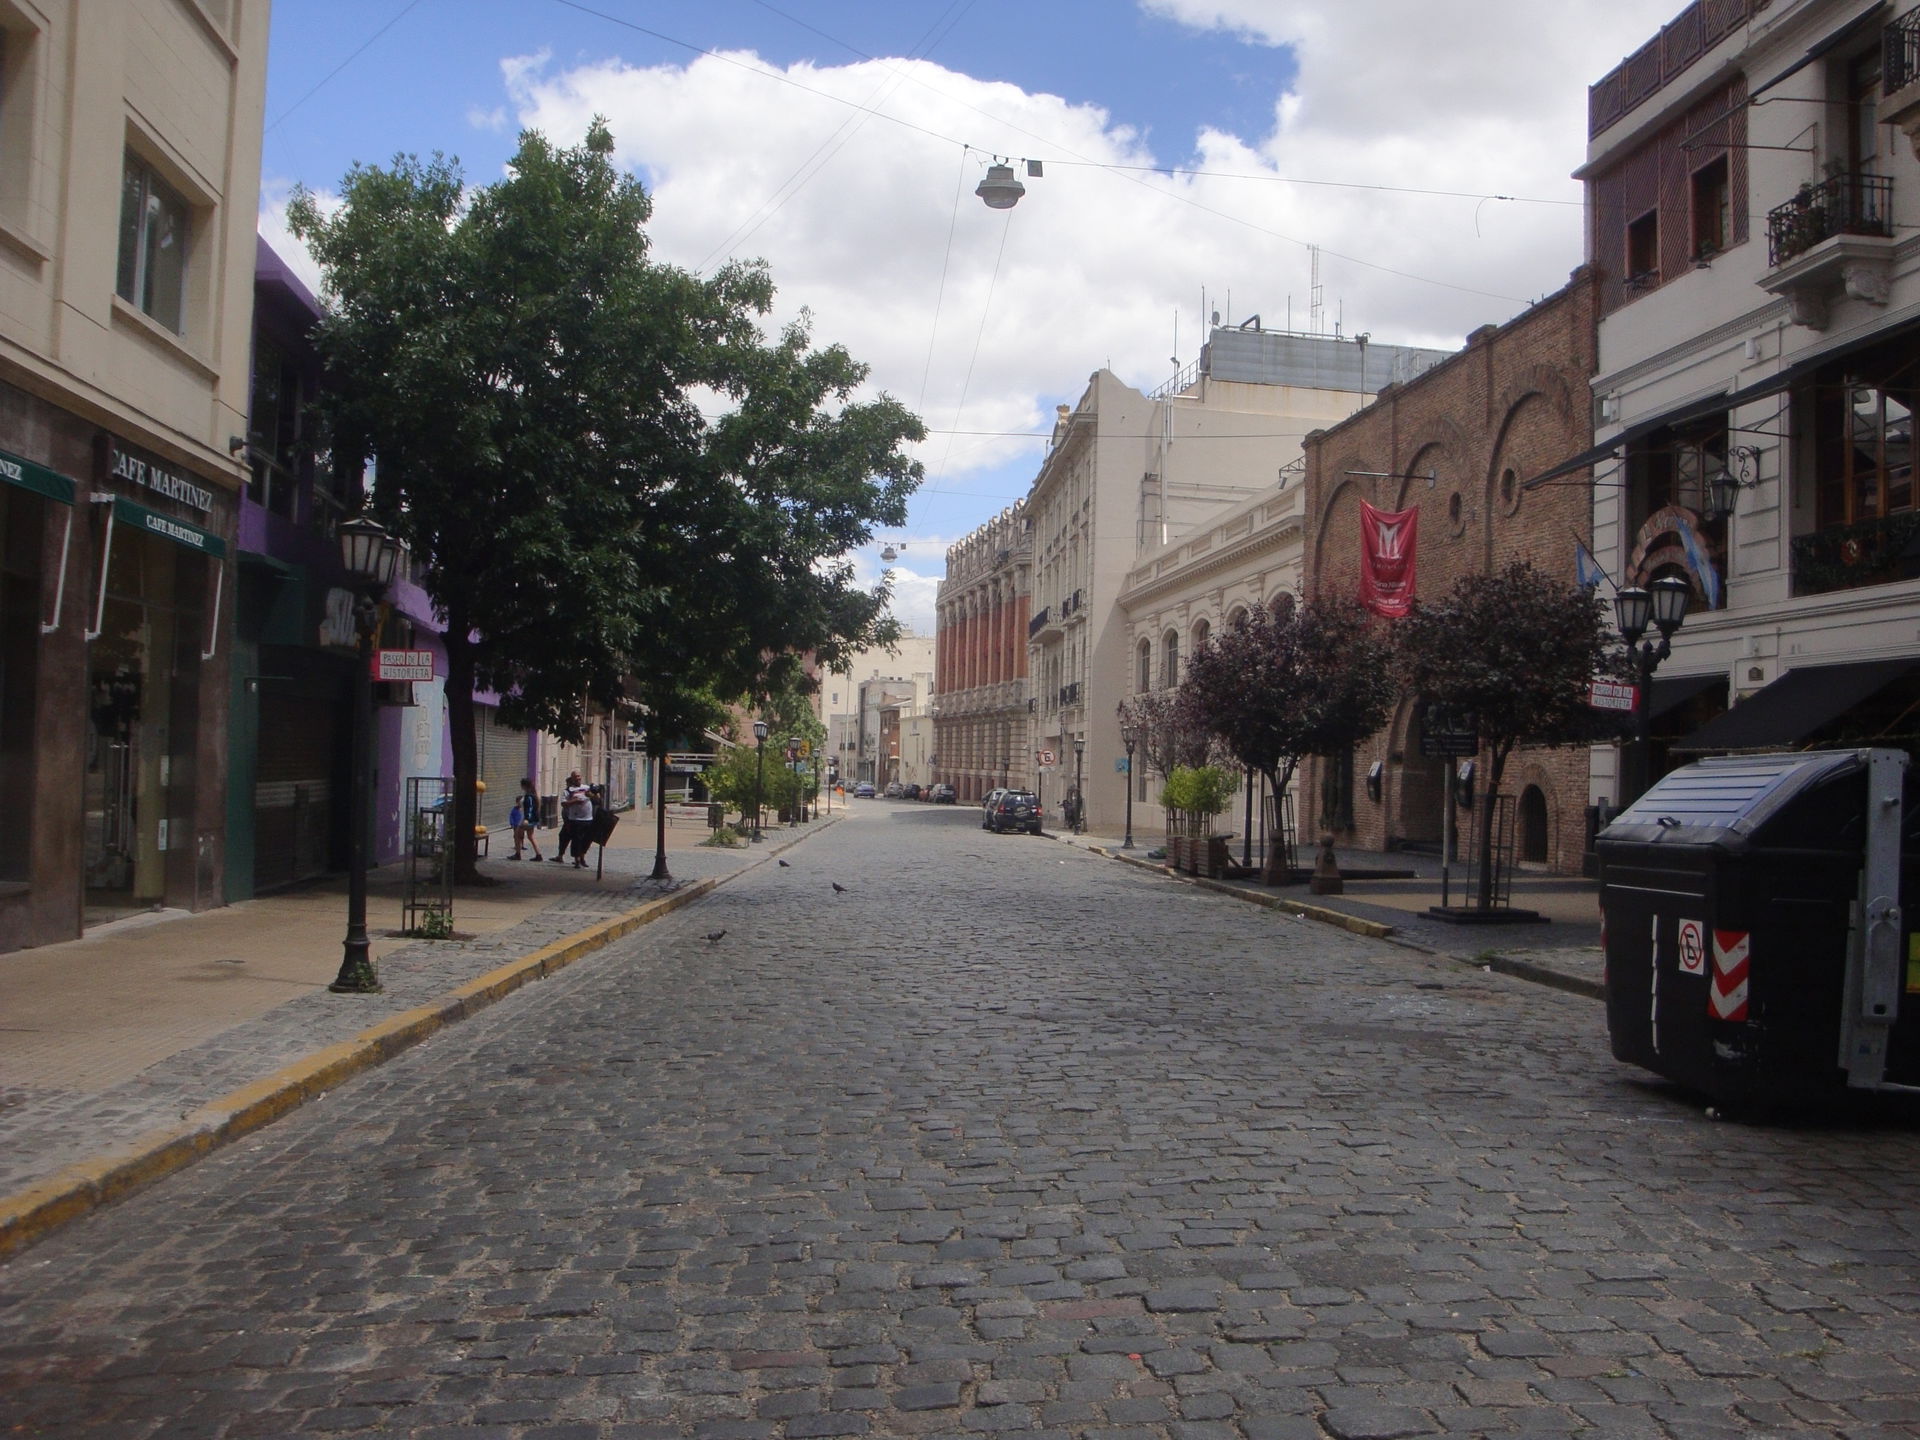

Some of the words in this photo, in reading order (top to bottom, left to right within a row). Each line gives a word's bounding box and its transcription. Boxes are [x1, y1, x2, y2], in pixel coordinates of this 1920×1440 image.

[150, 467, 213, 513] MARTINEZ
[146, 515, 167, 533] CAFE
[167, 522, 204, 547] MARTINEZ
[1375, 521, 1403, 560] M
[383, 653, 404, 665] PASEO
[407, 654, 416, 665] DE
[421, 653, 430, 664] LA
[383, 667, 430, 678] HISTORIETA
